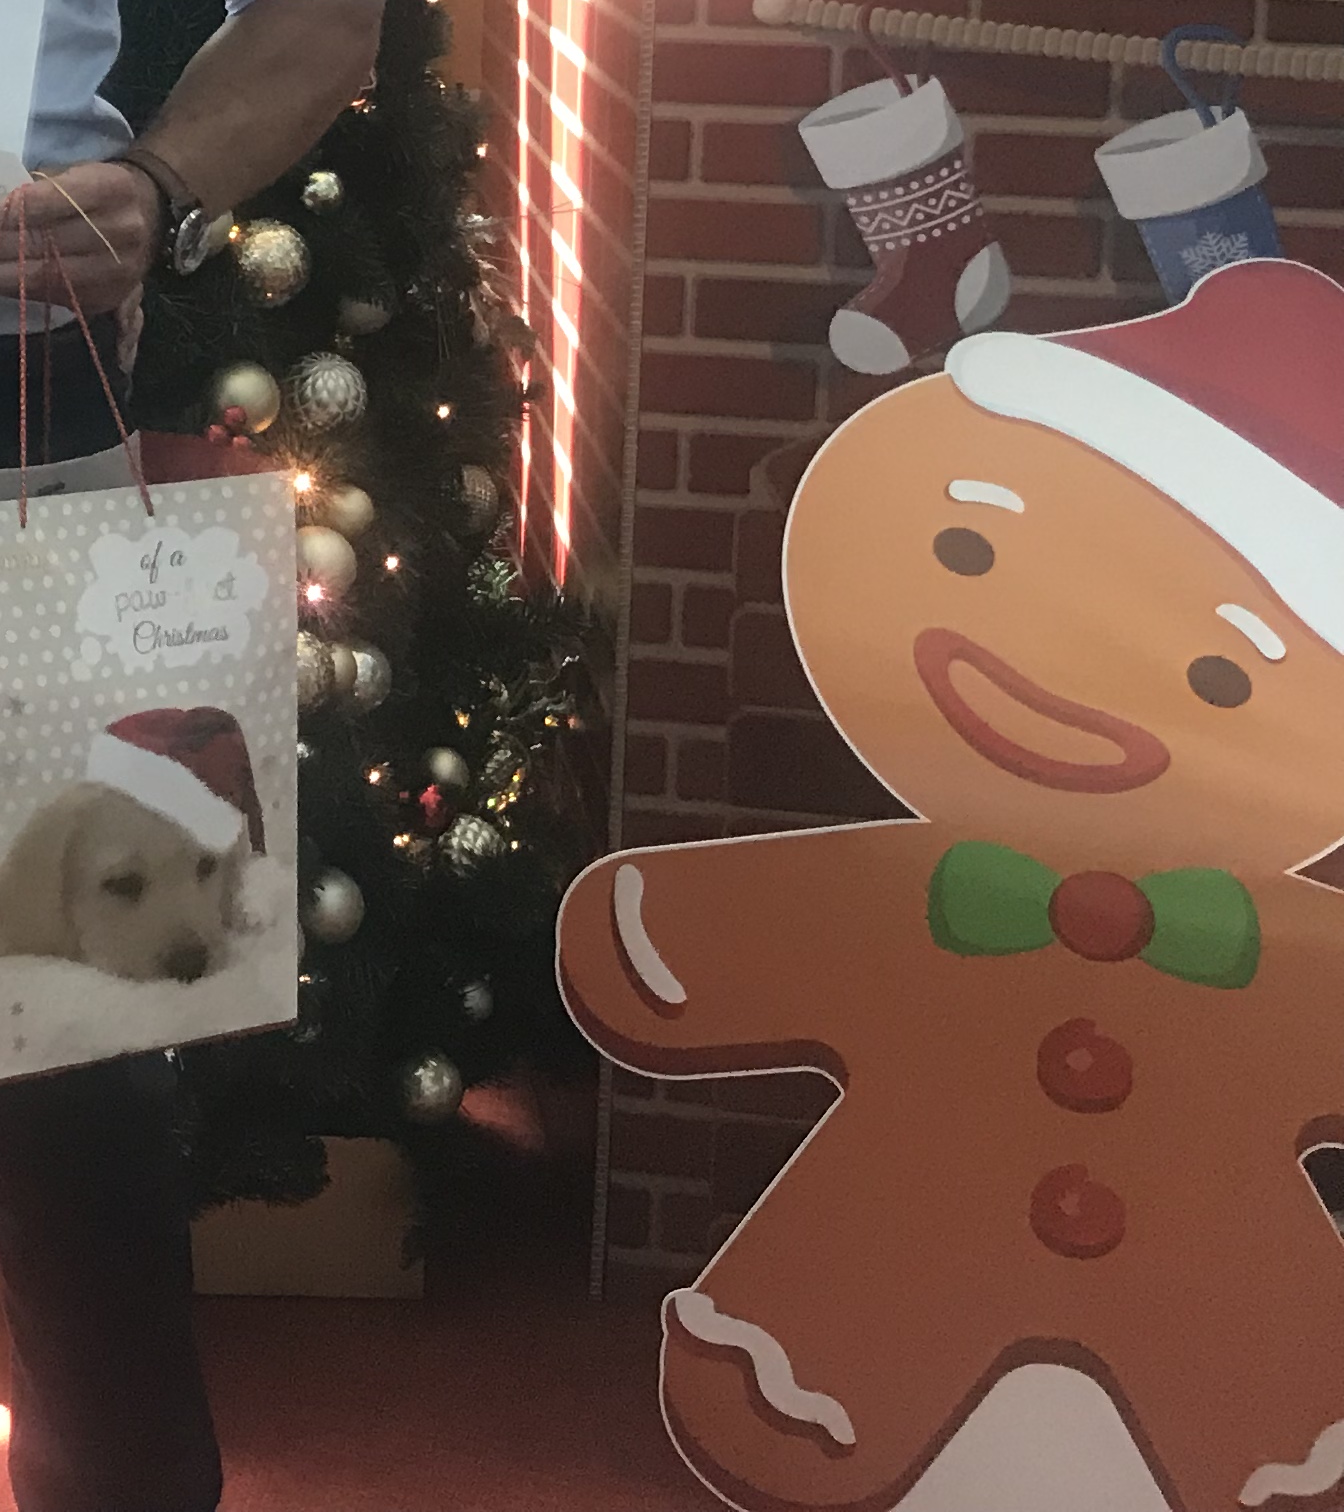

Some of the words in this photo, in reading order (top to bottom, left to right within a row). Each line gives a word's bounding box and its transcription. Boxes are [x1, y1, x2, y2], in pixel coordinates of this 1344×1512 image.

[139, 540, 163, 584] of
[169, 549, 188, 567] a
[133, 620, 229, 655] Christmas
